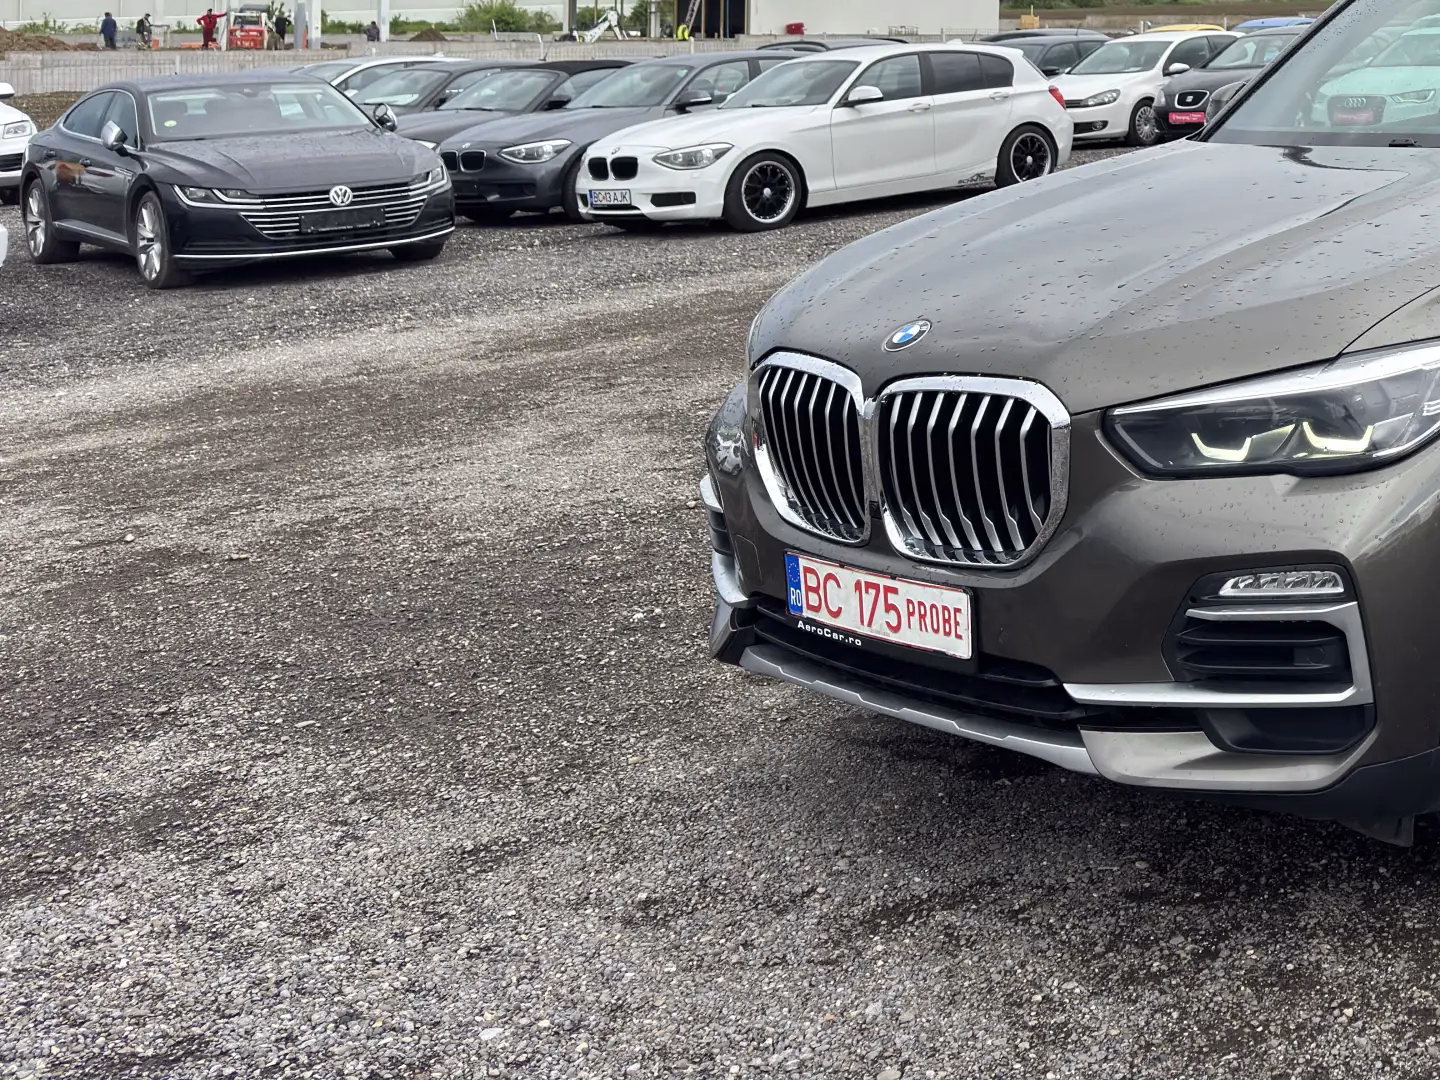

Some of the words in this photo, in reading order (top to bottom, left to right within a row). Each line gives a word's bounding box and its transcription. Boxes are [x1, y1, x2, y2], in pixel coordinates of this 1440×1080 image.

[613, 191, 629, 202] AJK
[790, 587, 802, 607] RO
[802, 565, 843, 618] BC
[854, 578, 901, 633] 175
[905, 598, 963, 640] PROBE
[797, 619, 862, 646] AeroCar.ro
